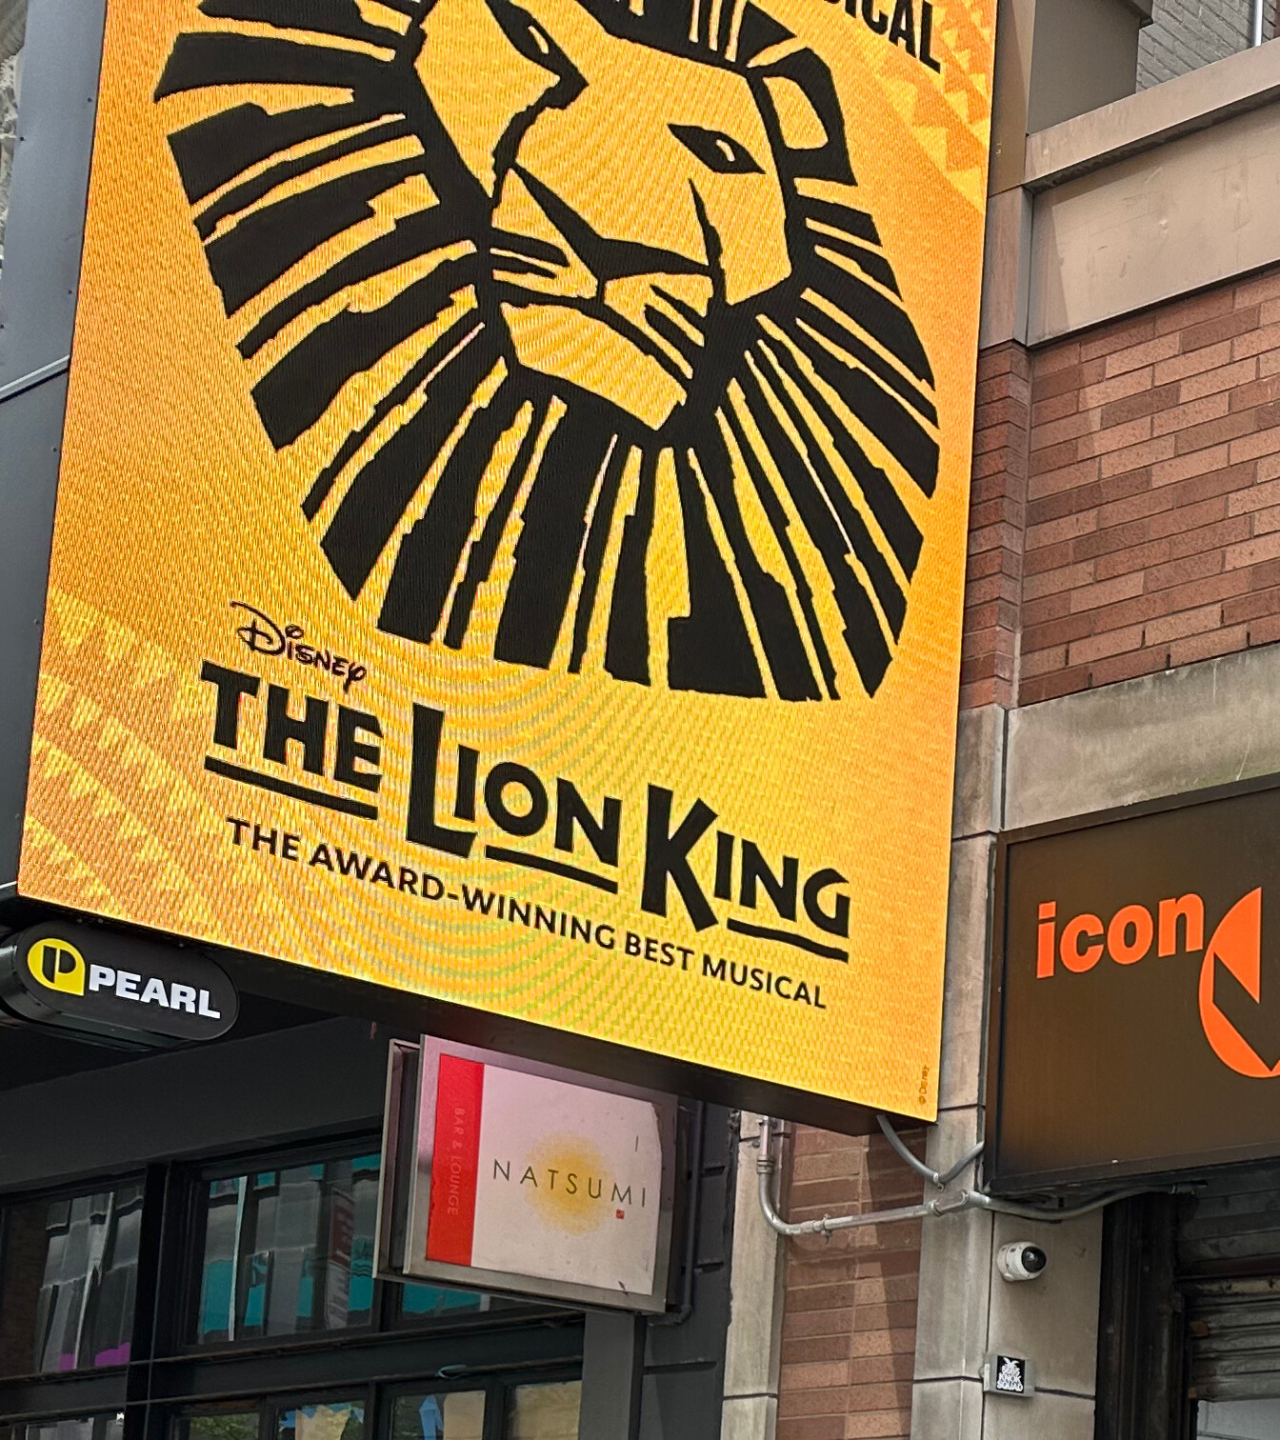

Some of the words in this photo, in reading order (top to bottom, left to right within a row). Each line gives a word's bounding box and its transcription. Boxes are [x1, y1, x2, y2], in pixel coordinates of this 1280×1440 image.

[200, 658, 384, 790] THE
[226, 816, 300, 860] THE
[308, 842, 616, 951] AWARD-WINNING
[624, 934, 694, 973] BEST
[702, 954, 827, 1010] MUSICAL
[1036, 892, 1203, 980] icon
[89, 963, 221, 1019] PEARL
[453, 1107, 466, 1136] BAR
[447, 1155, 462, 1216] LOUNGE
[492, 1158, 646, 1208] NATSUMI
